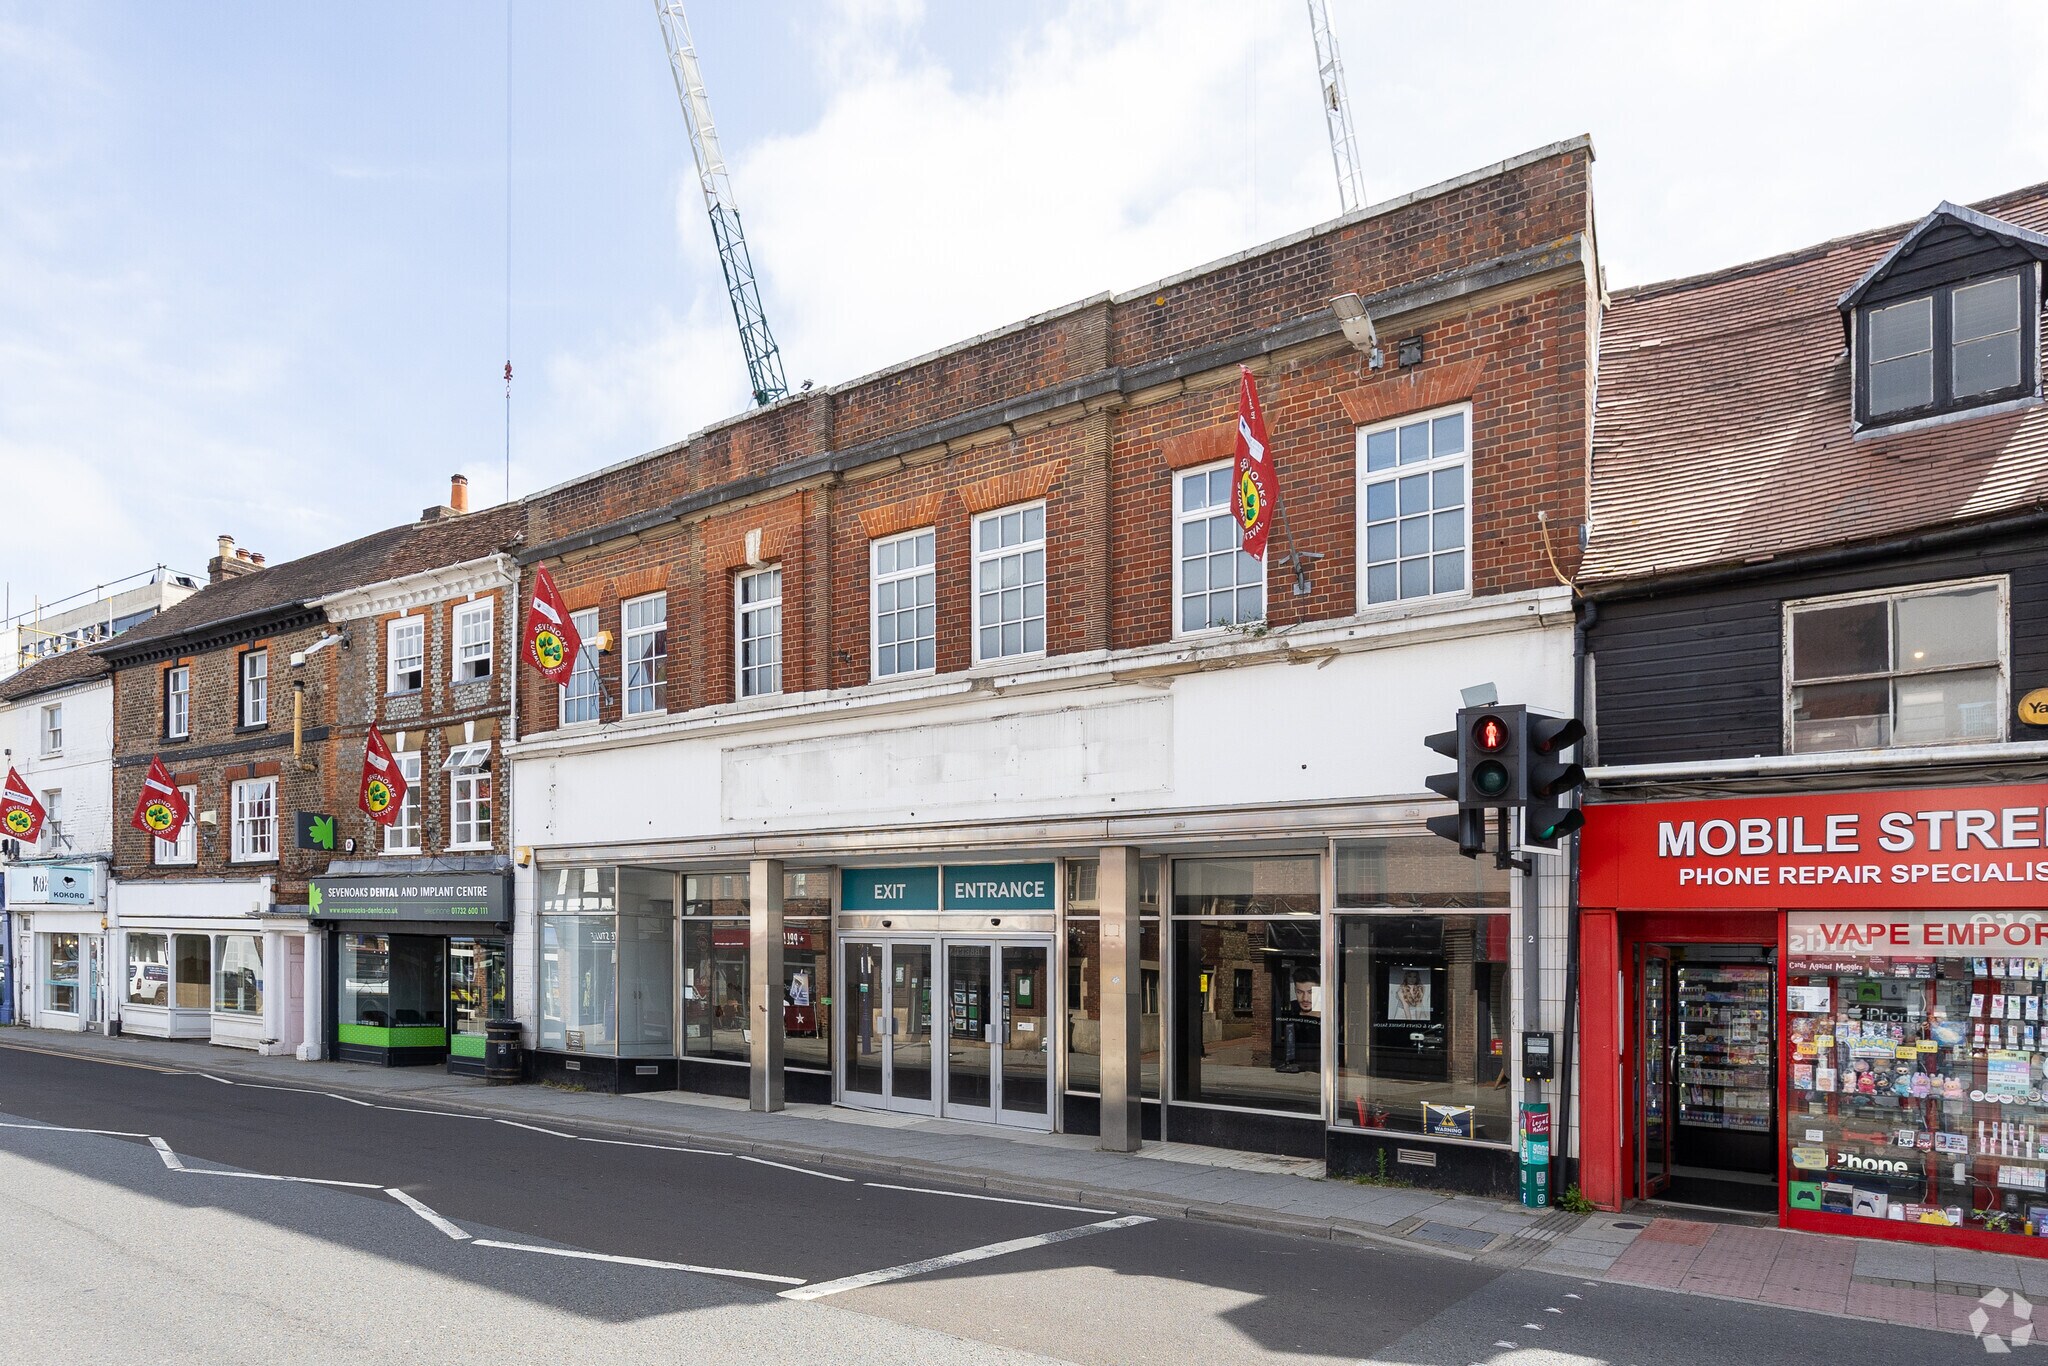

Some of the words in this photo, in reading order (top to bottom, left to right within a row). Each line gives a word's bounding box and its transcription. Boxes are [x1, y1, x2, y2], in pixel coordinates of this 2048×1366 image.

[6, 804, 37, 822] SEVENOAKS
[146, 798, 178, 819] SEVENOAKS
[1658, 814, 1860, 857] MOBILE
[1878, 806, 2048, 852] STRE
[1679, 867, 1770, 886] PHONE
[1779, 865, 1882, 885] REPAIR
[1890, 861, 2048, 884] SPECIALIS
[328, 887, 368, 898] SEVENOAKS
[370, 887, 398, 898] DENTAL
[401, 887, 418, 897] AND
[420, 886, 454, 897] IMPLANT
[456, 886, 488, 897] CENTRE
[874, 883, 906, 900] EXIT
[954, 881, 1045, 899] ENTRANCE
[451, 907, 466, 915] 01732
[468, 907, 478, 915] 600
[480, 907, 488, 915] 111
[1820, 923, 1910, 945] VAPE
[1788, 962, 1807, 970] Cards
[1809, 962, 1832, 971] Against
[1836, 962, 1863, 972] Muggles
[1866, 1007, 1920, 1023] iPhone
